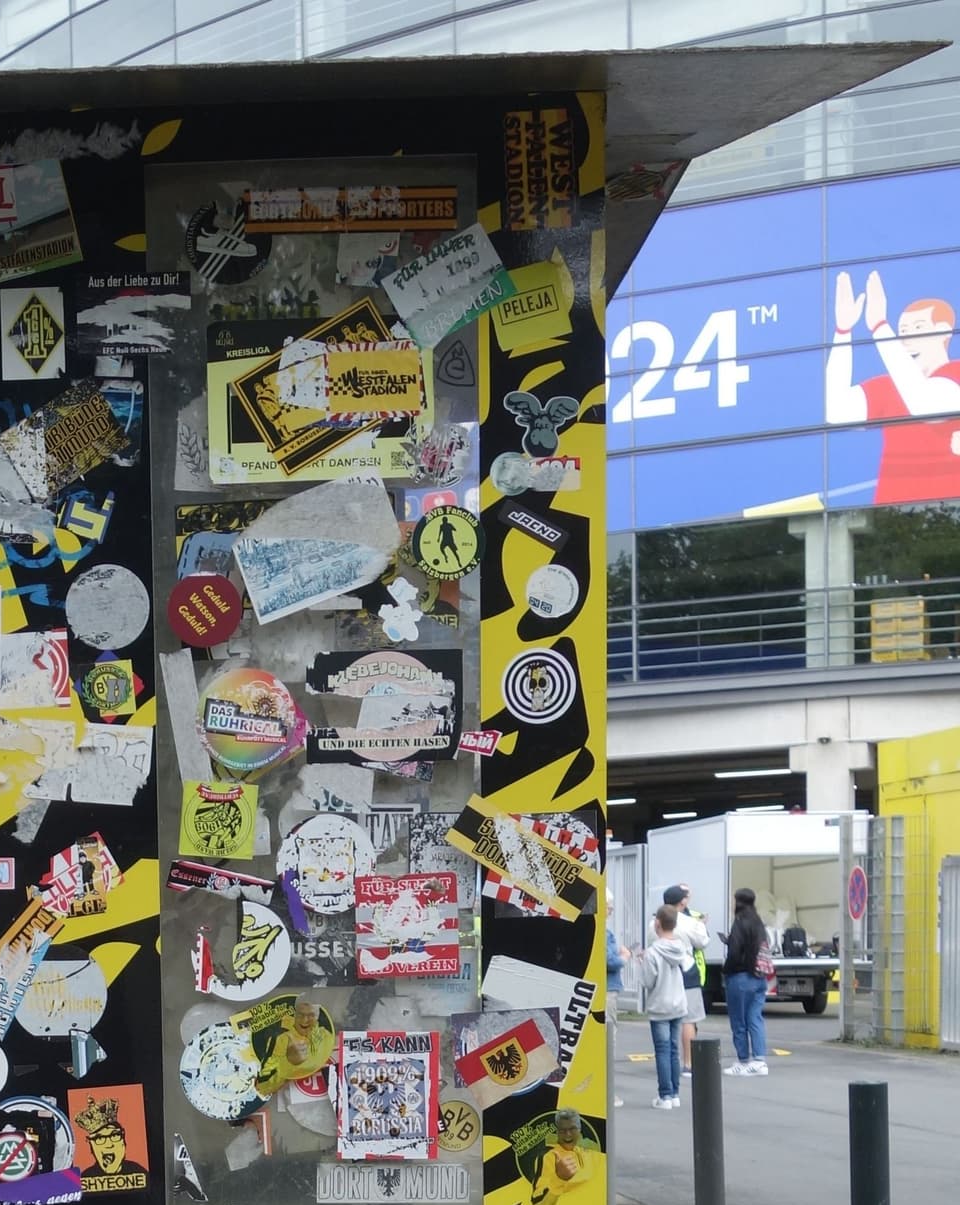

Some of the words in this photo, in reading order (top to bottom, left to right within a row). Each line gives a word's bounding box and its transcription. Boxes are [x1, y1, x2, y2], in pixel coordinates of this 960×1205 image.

[87, 276, 105, 288] Aus
[107, 275, 122, 287] der
[124, 274, 150, 287] Liebe
[151, 276, 161, 286] zu
[163, 272, 180, 286] Dir!
[503, 292, 553, 319] PELEJA
[226, 346, 271, 359] KREISLIGA
[342, 367, 417, 388] WESTFALEN
[352, 383, 408, 398] STADION
[202, 584, 232, 614] Geduld
[188, 592, 218, 627] Watson,
[177, 605, 208, 636] Geduld!
[210, 704, 234, 717] DAS
[322, 739, 345, 750] UND
[347, 738, 366, 749] DIE
[368, 737, 411, 749] ECHTEN
[413, 736, 449, 748] HASEN
[380, 1036, 432, 1054] KANN
[441, 1105, 475, 1142] BVB
